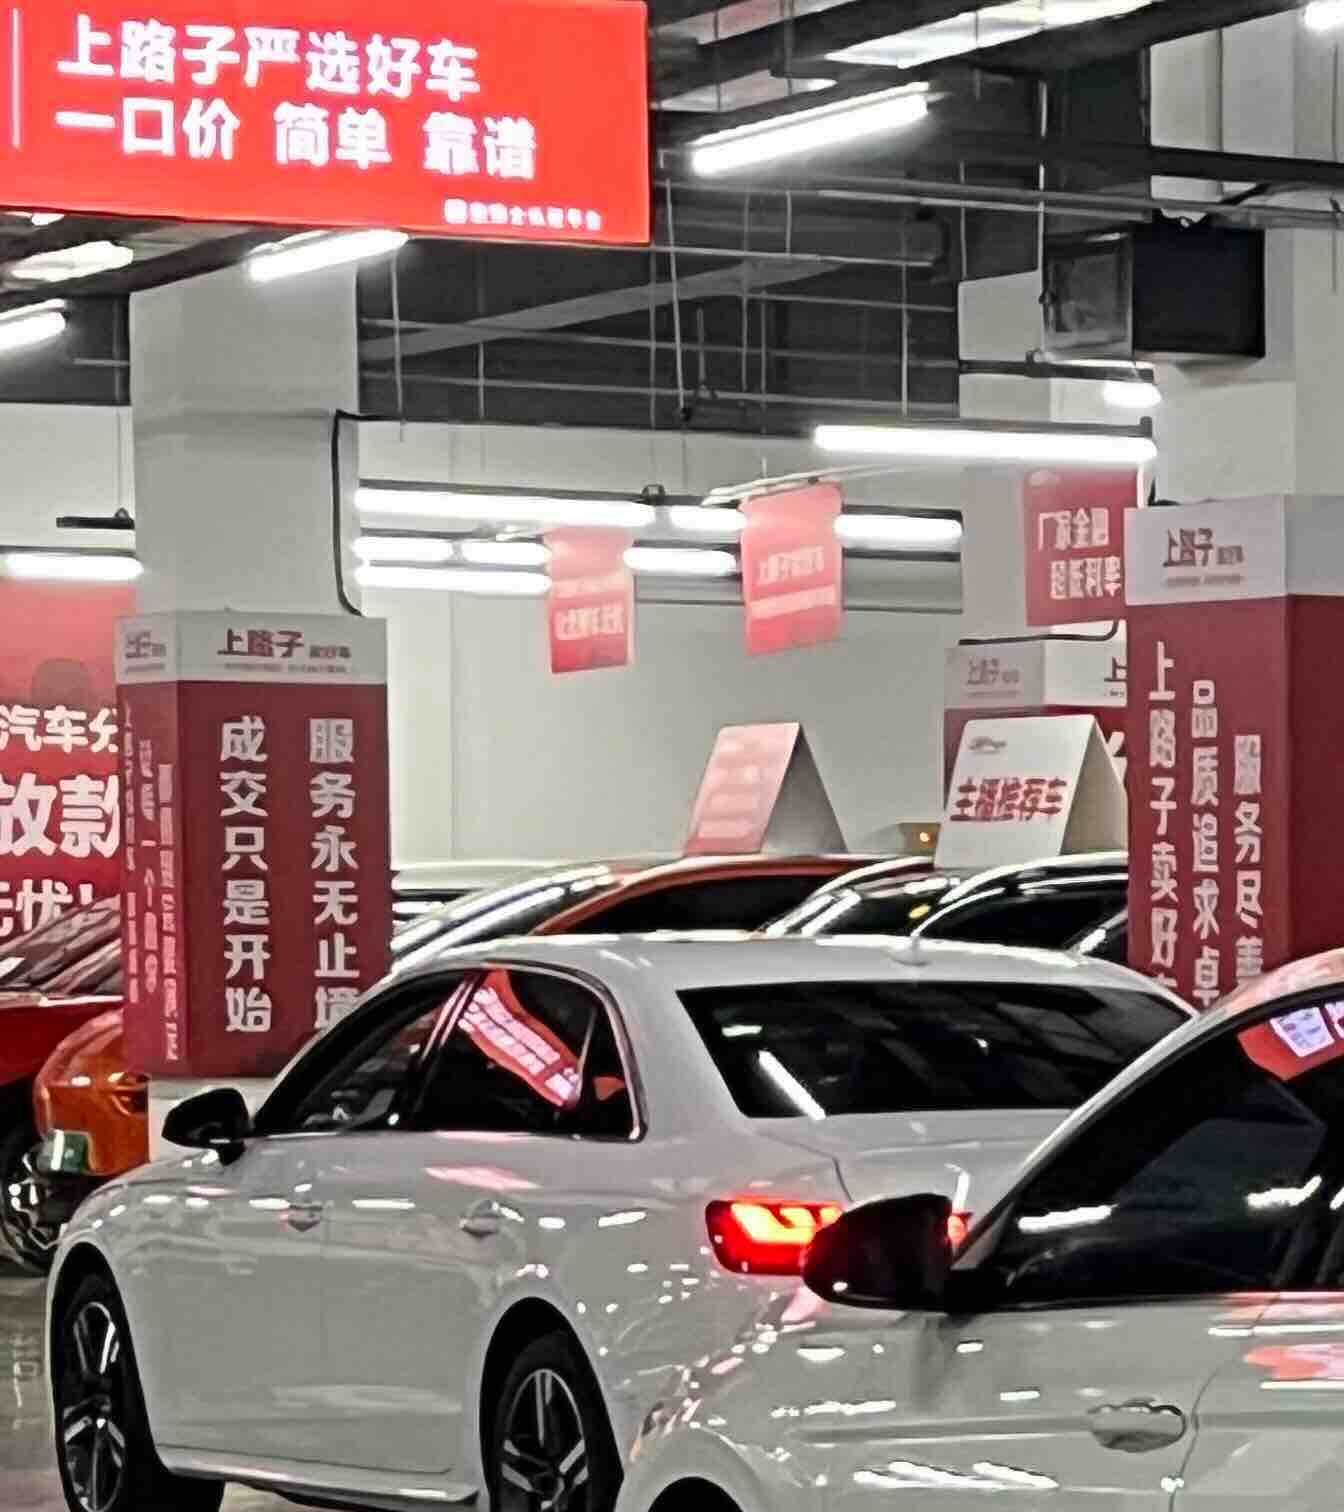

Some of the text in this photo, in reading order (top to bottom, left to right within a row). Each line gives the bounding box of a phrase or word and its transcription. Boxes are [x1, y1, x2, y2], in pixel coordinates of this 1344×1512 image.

[57, 14, 481, 101] 上路子严选好车
[55, 97, 537, 179] 一口价 简单 靠谱
[217, 628, 304, 658] 上路子
[220, 715, 272, 1033] 成交只是开始
